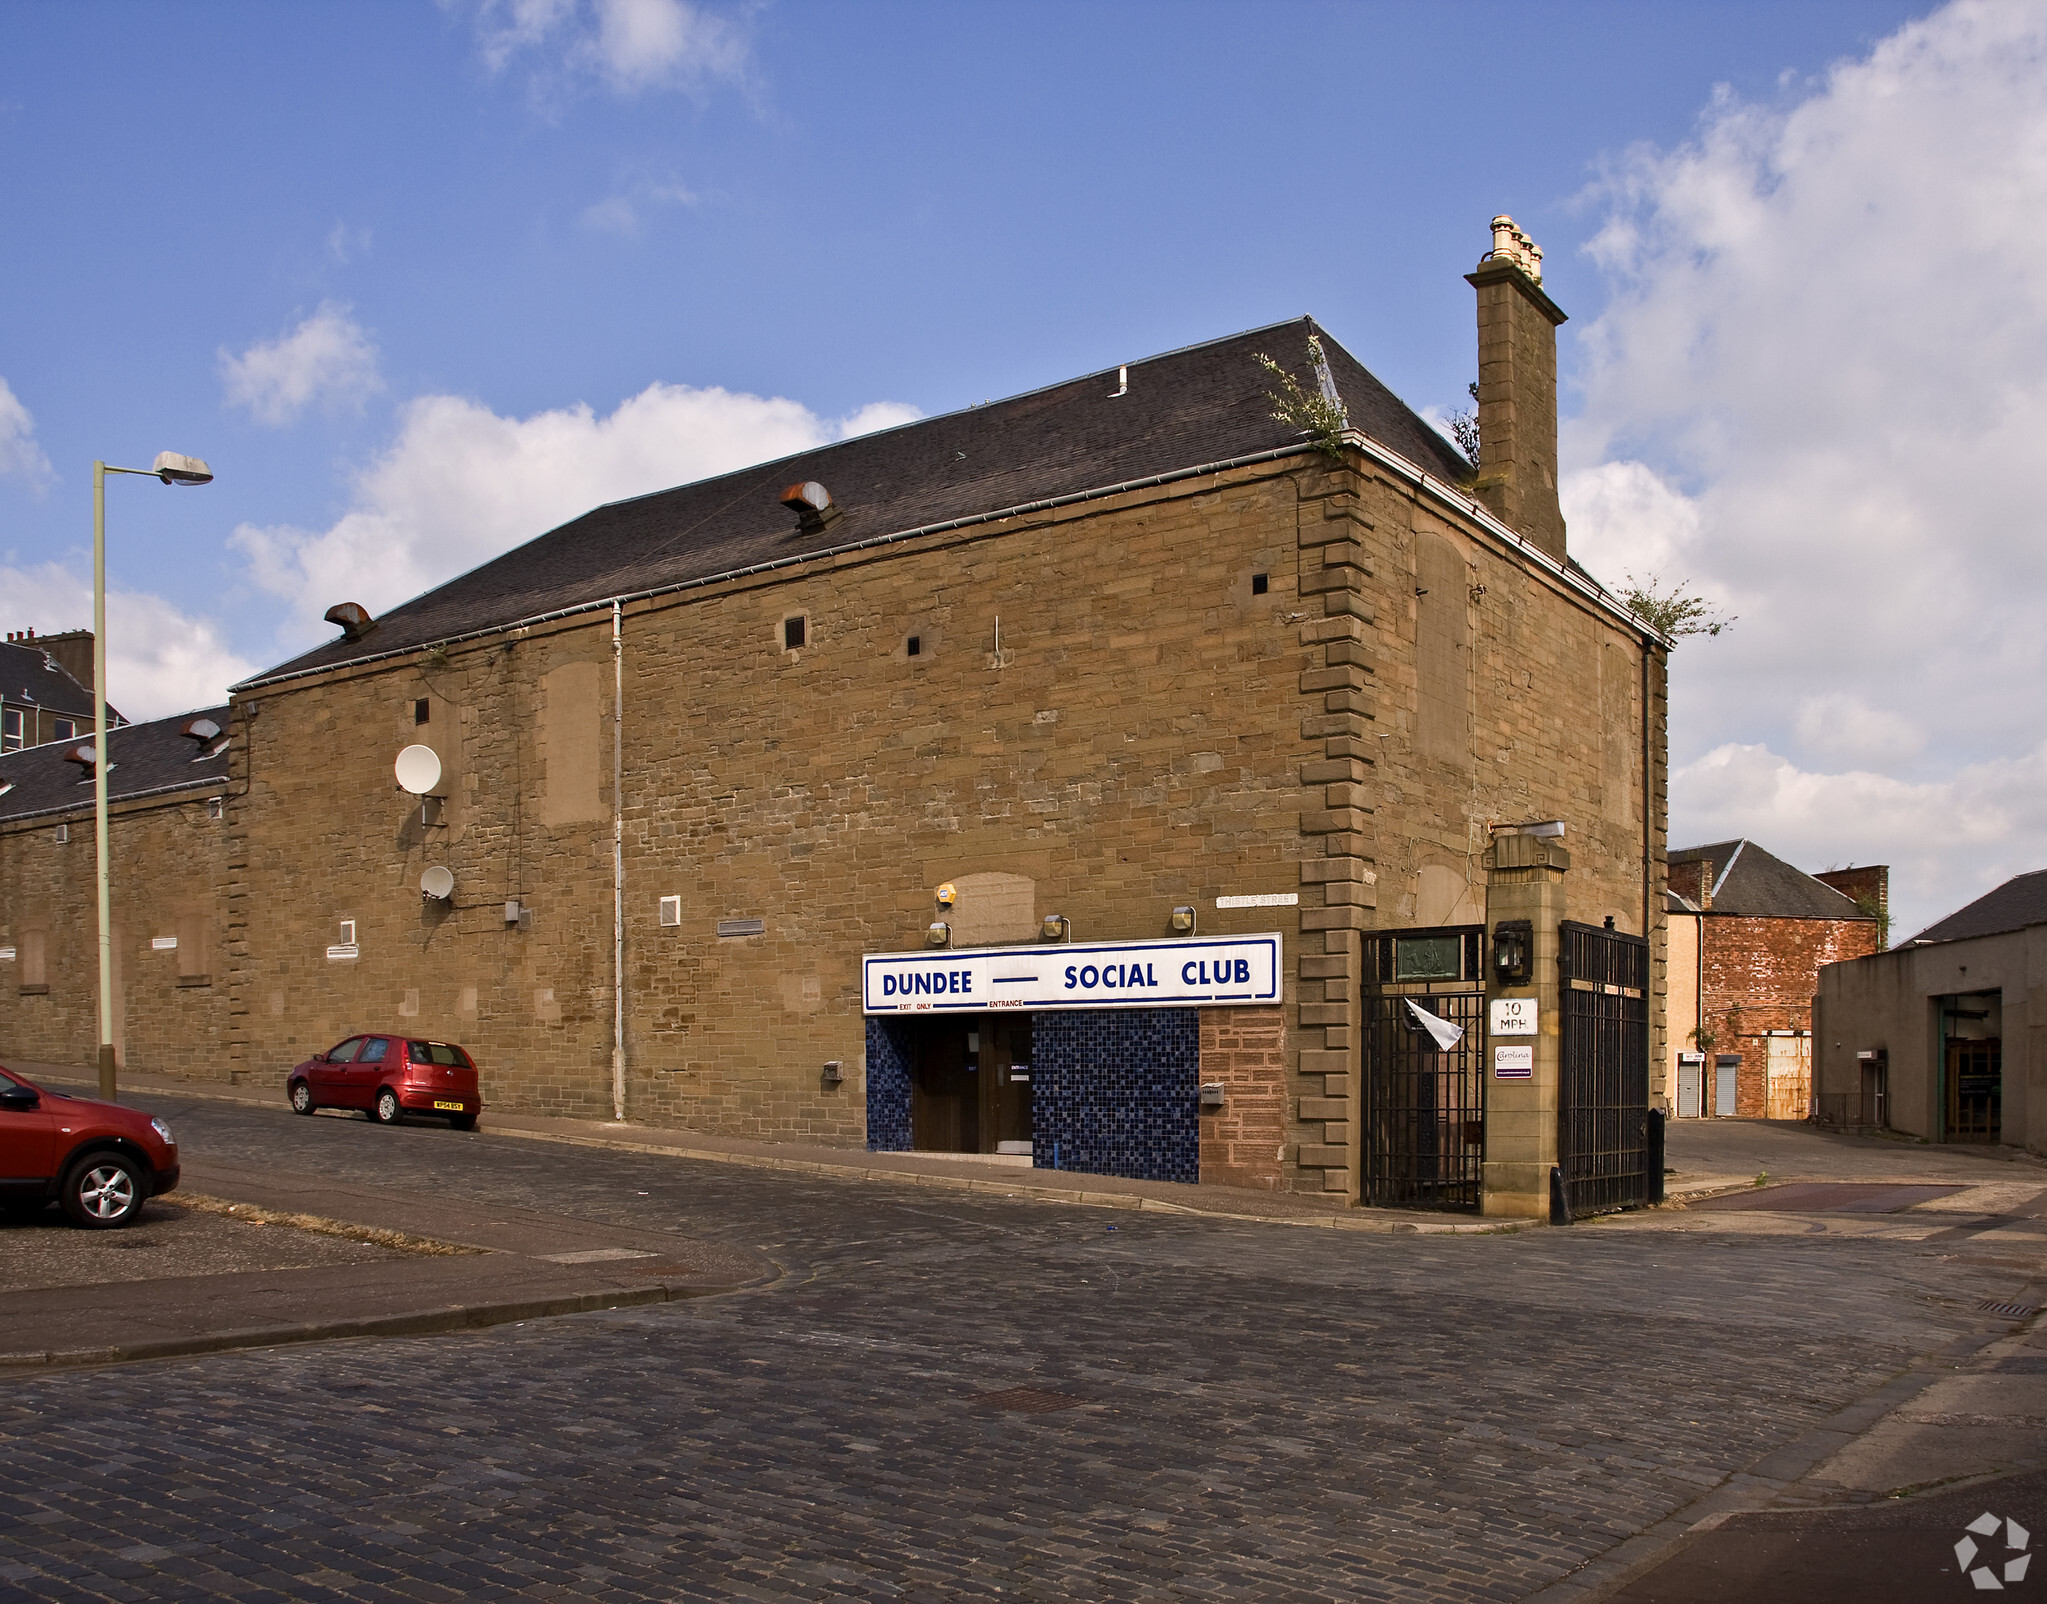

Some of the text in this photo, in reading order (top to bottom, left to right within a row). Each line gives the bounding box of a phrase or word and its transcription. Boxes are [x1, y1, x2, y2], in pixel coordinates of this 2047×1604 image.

[1218, 894, 1295, 907] THISTLE STREET
[883, 959, 1250, 996] DUNDEE SOCIAL CLUB
[899, 1002, 932, 1011] EXIT ONLY
[989, 999, 1023, 1008] ENTRANCE
[1505, 1002, 1521, 1016] 10
[1500, 1019, 1528, 1029] MPH
[1496, 1051, 1530, 1062] Carolina
